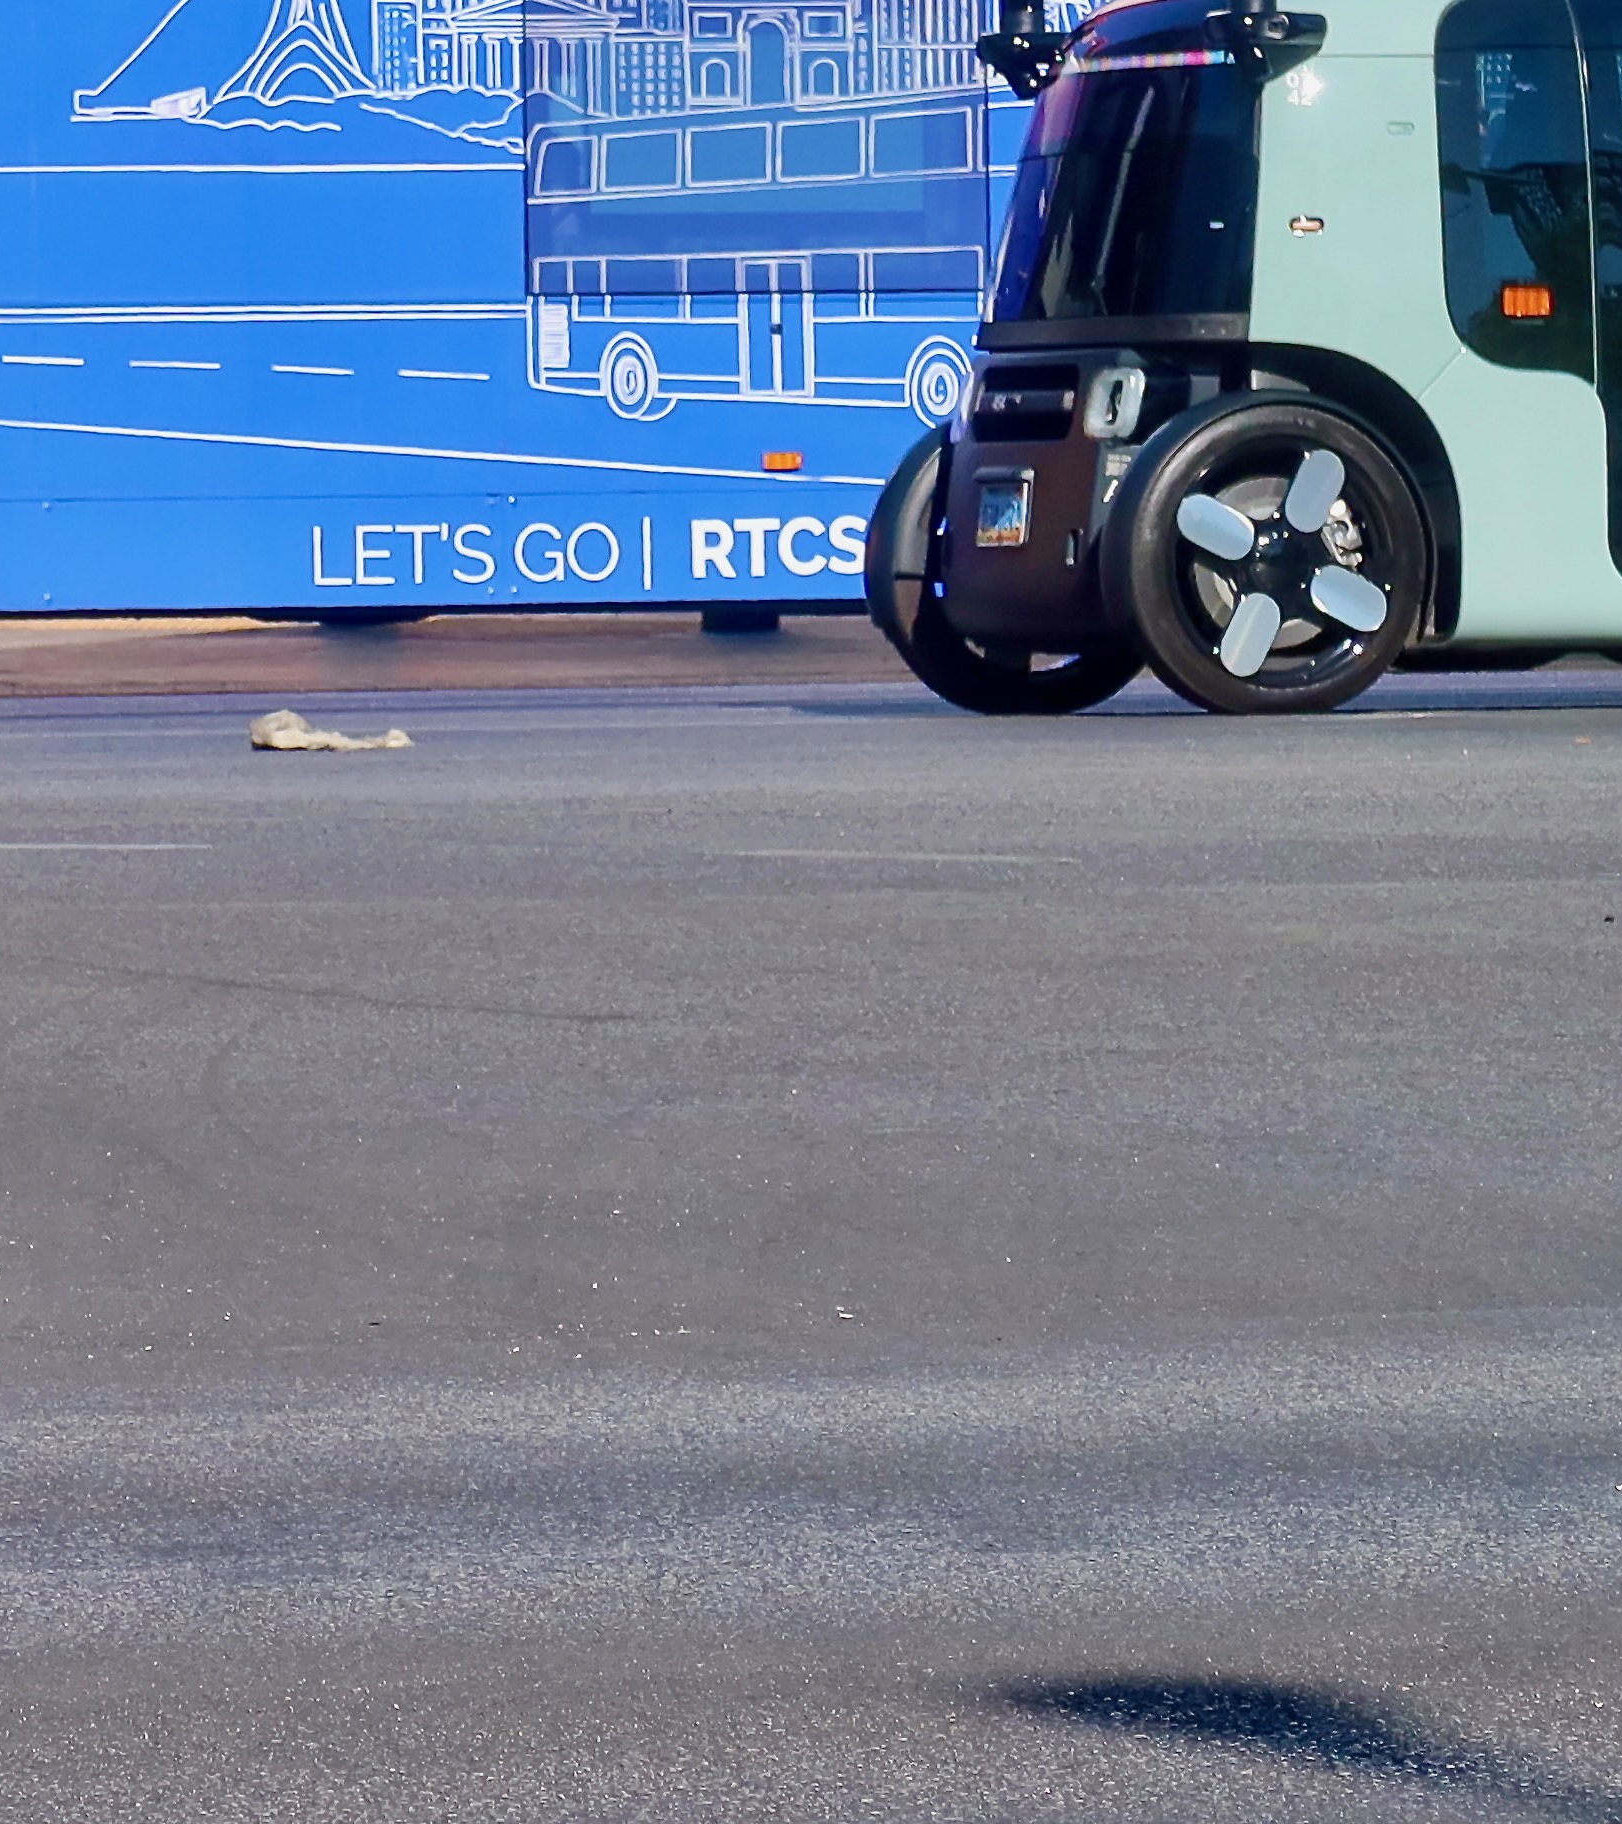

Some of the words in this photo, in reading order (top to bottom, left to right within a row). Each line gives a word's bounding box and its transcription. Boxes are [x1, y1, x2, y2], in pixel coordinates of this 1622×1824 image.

[312, 522, 496, 587] LET'S
[512, 522, 620, 583] GO
[690, 515, 866, 580] RTCS
